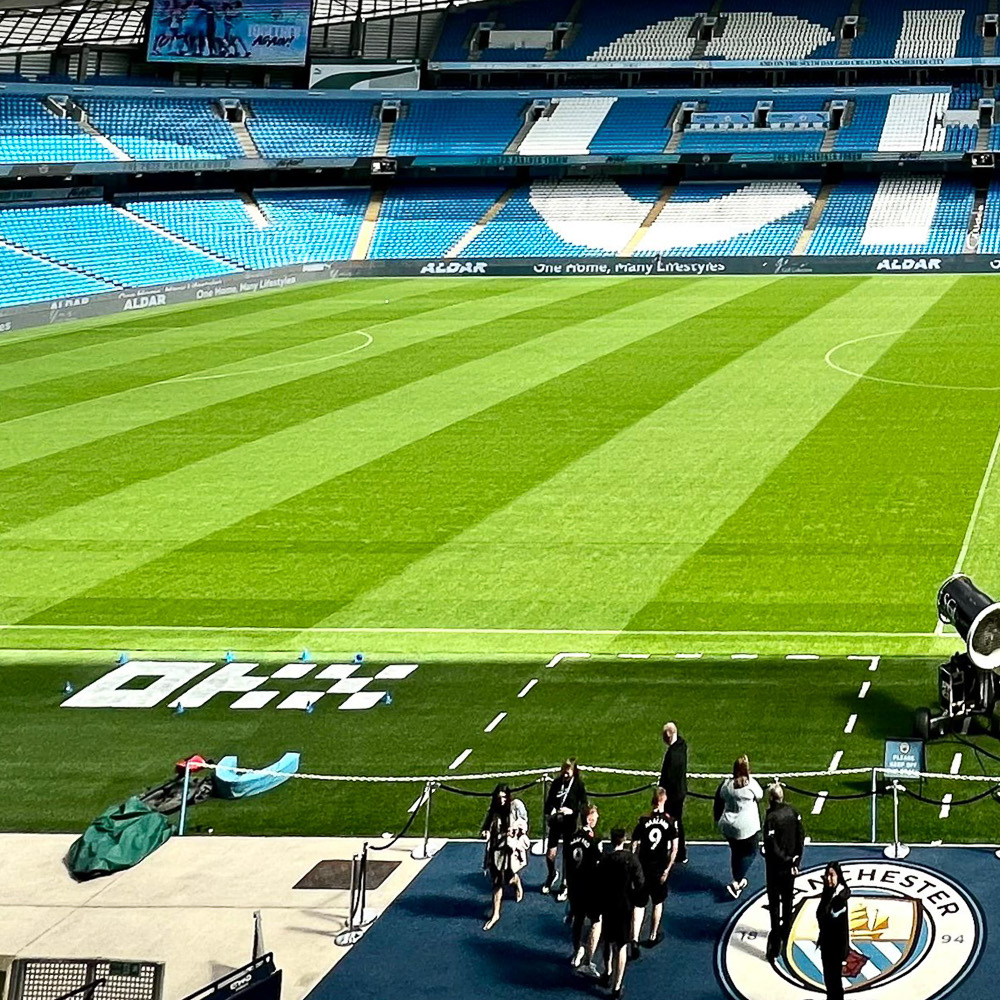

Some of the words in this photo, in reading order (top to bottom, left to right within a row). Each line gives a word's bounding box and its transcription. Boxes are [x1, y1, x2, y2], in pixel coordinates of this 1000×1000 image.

[420, 262, 488, 275] ALDAR
[533, 263, 562, 274] One
[615, 263, 652, 276] Many
[876, 259, 942, 271] ALDAR
[196, 289, 214, 300] One
[240, 281, 258, 292] Many
[259, 276, 297, 289] Lifestyles
[123, 294, 167, 311] ALDAR
[60, 660, 419, 710] OKX
[892, 754, 916, 762] PLEASE
[648, 827, 663, 851] 9
[941, 933, 965, 945] 94
